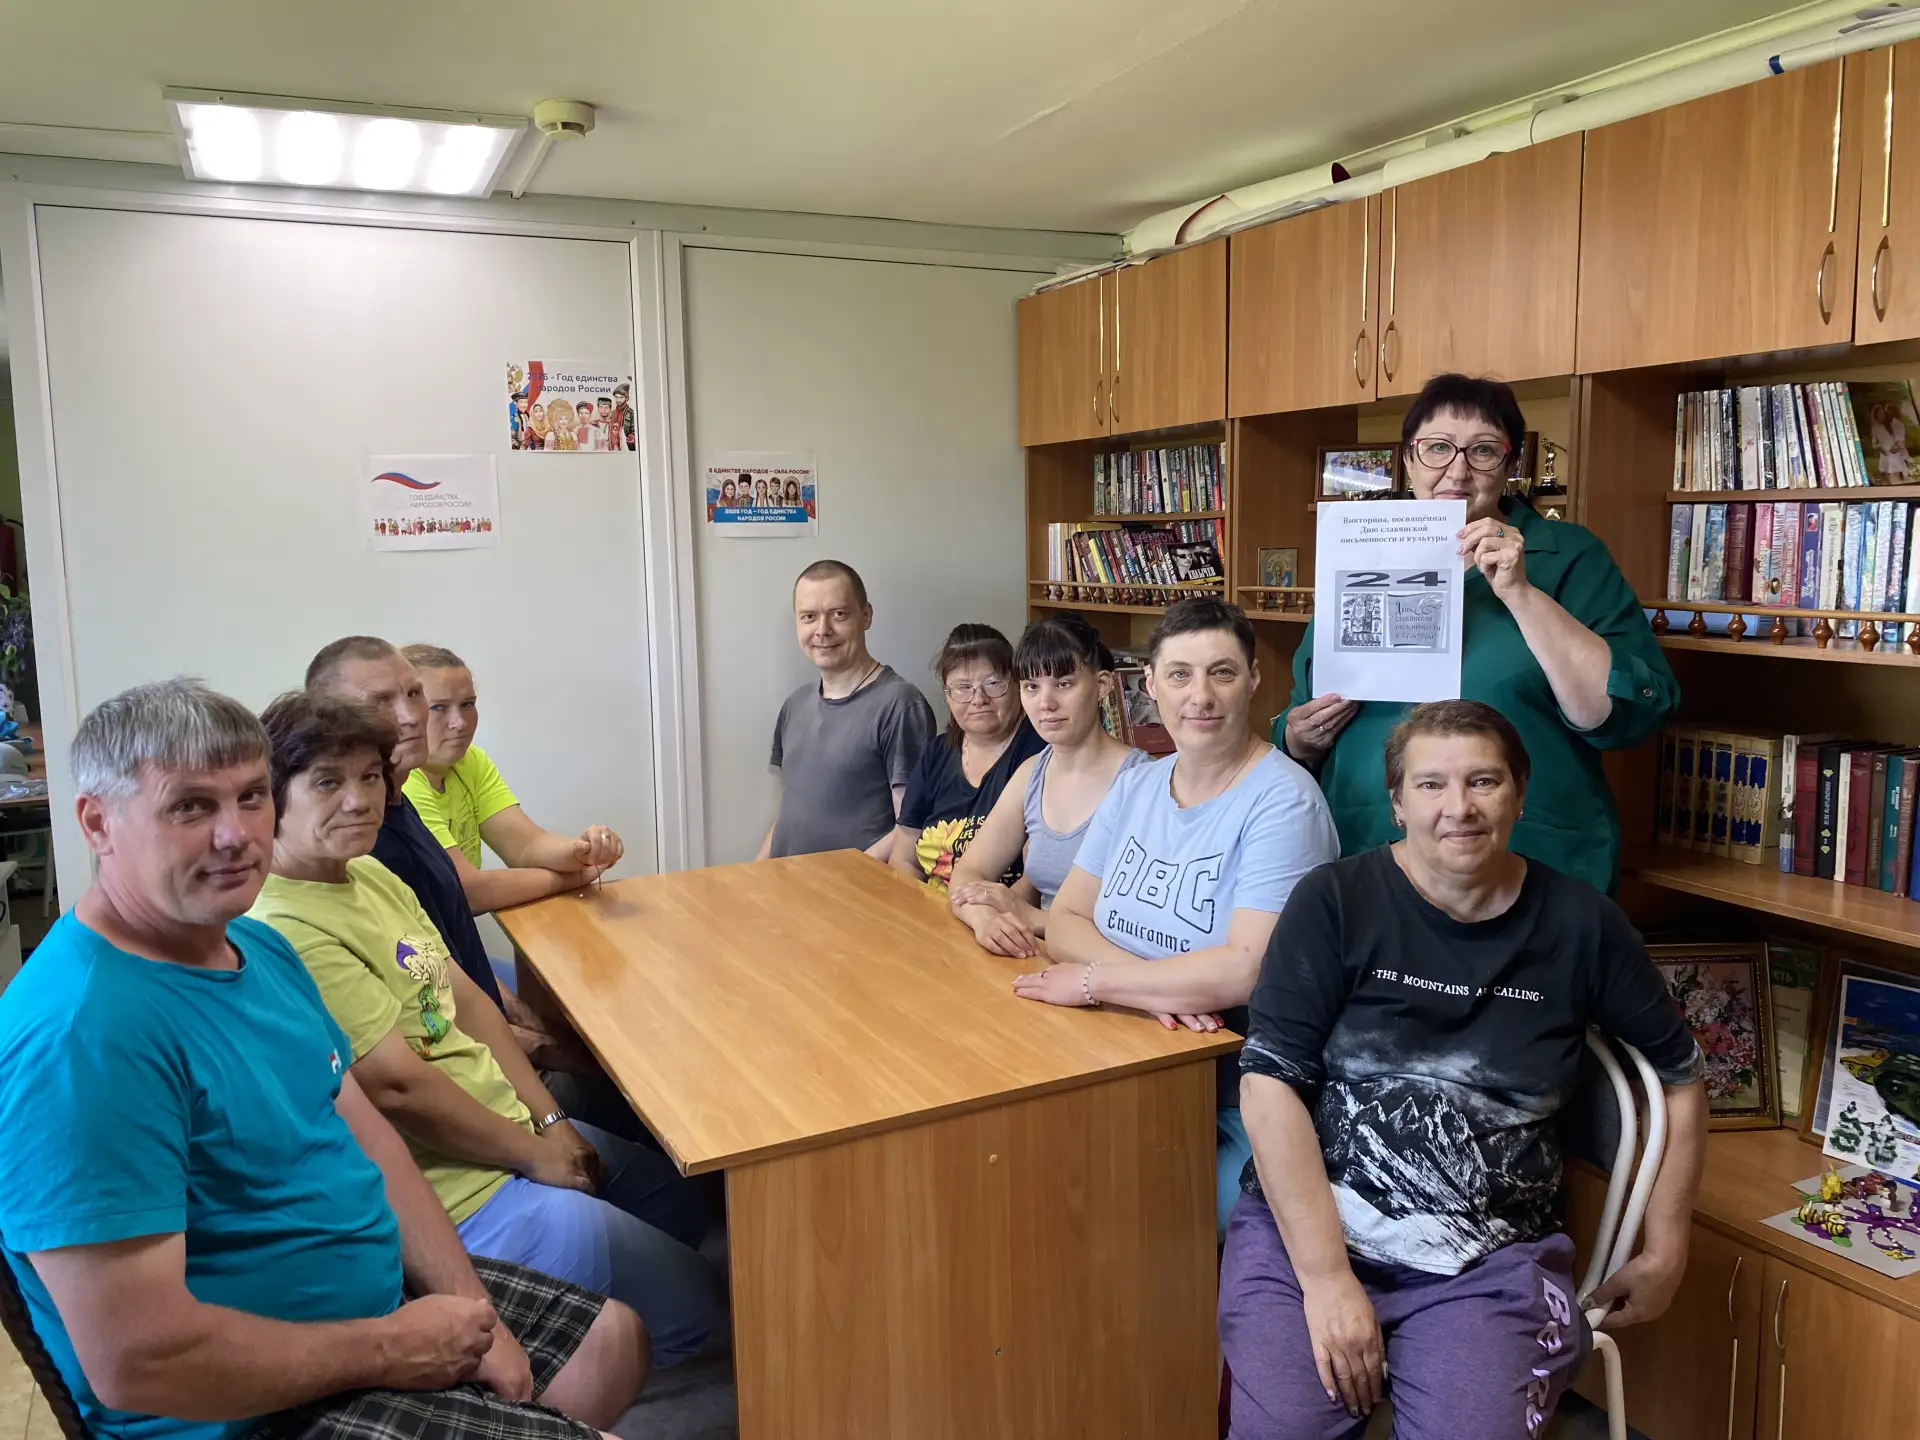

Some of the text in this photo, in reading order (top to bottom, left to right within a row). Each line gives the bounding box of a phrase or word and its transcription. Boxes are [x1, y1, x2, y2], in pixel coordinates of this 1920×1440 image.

[557, 373, 573, 383] Год
[576, 374, 618, 383] единства
[579, 385, 612, 393] России
[1360, 525, 1428, 534] Дню славянской
[1345, 571, 1446, 587] 24
[1875, 762, 1883, 771] 2
[1103, 835, 1224, 935] ABC
[1402, 974, 1470, 996] MOUNTAINS
